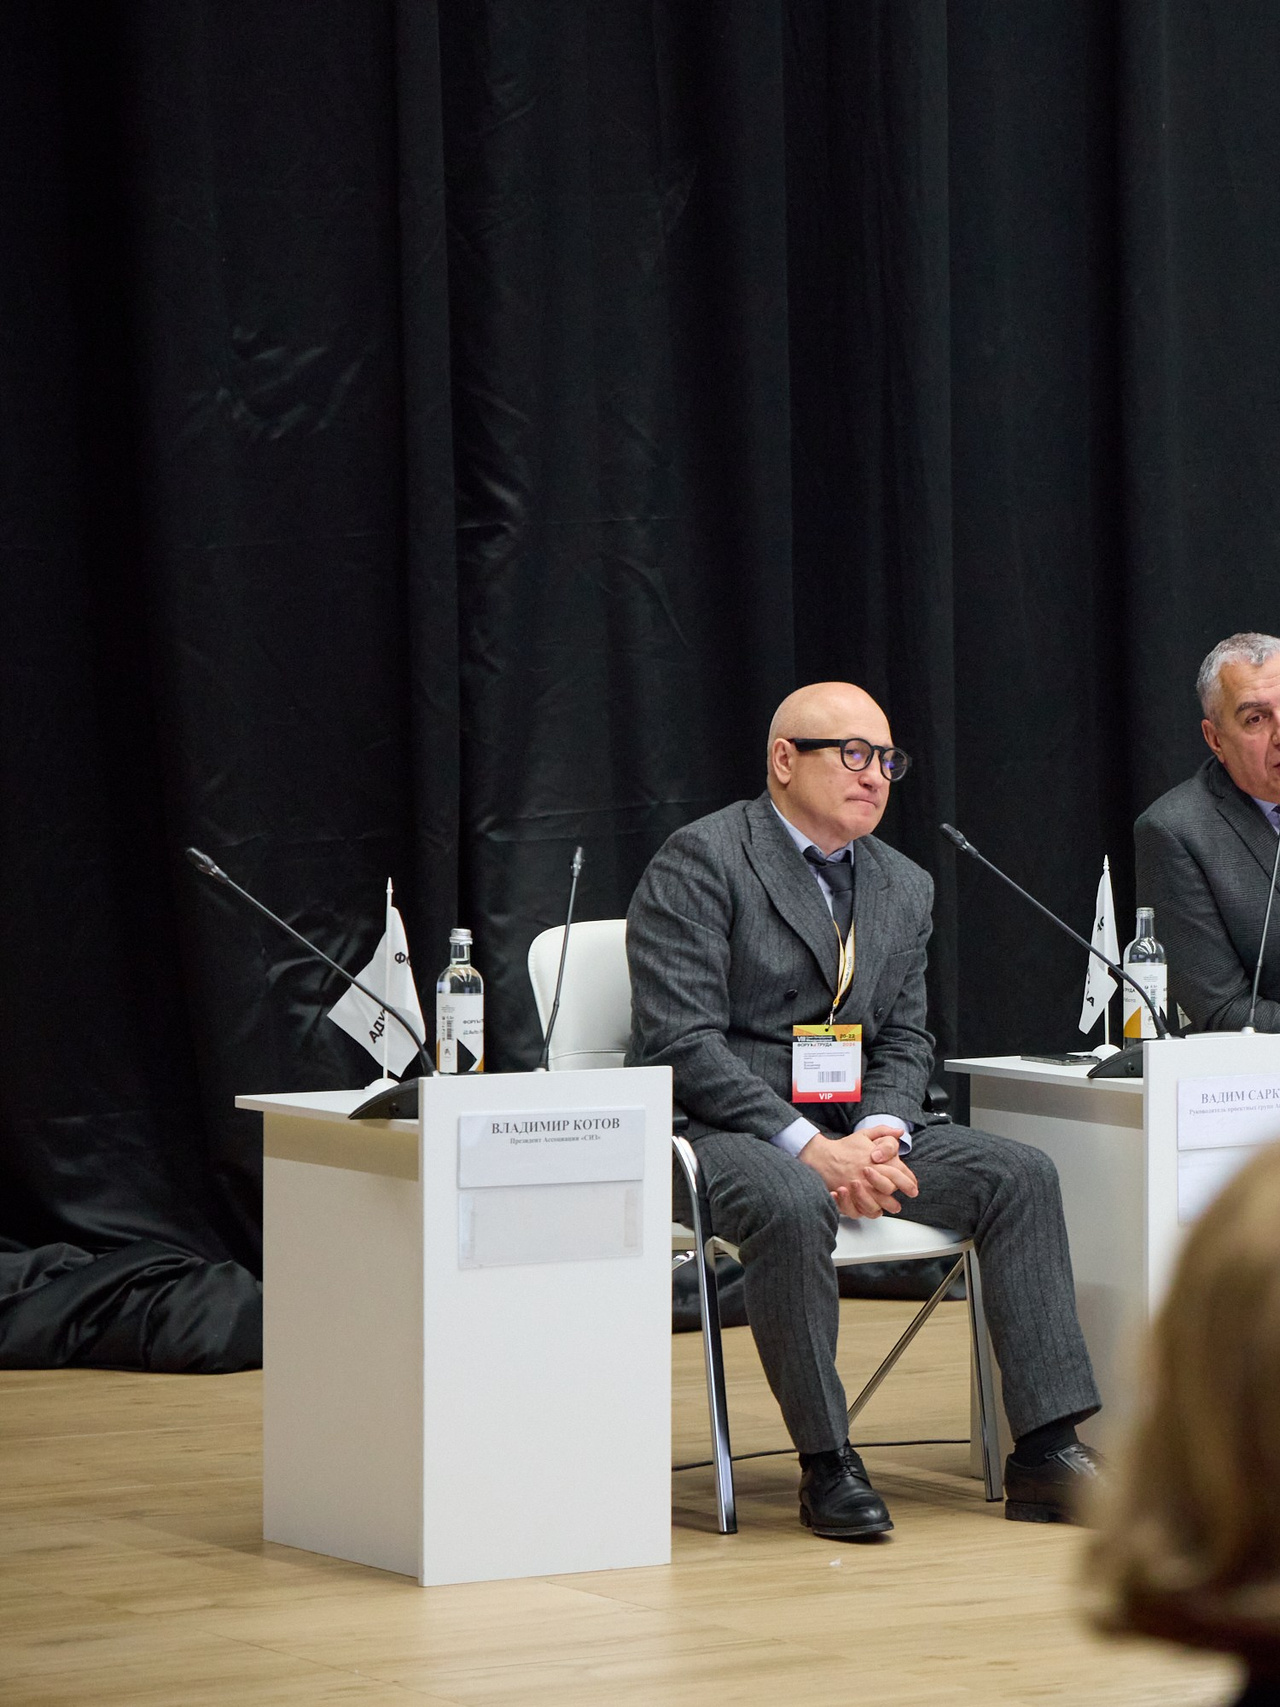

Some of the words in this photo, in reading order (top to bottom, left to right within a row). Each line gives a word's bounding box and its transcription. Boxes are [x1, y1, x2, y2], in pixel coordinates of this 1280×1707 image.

[1201, 1090, 1245, 1104] ВАДИМ
[491, 1119, 570, 1135] ВЛАДИМИР
[573, 1117, 620, 1131] КОТОВ
[510, 1137, 542, 1145] Президент
